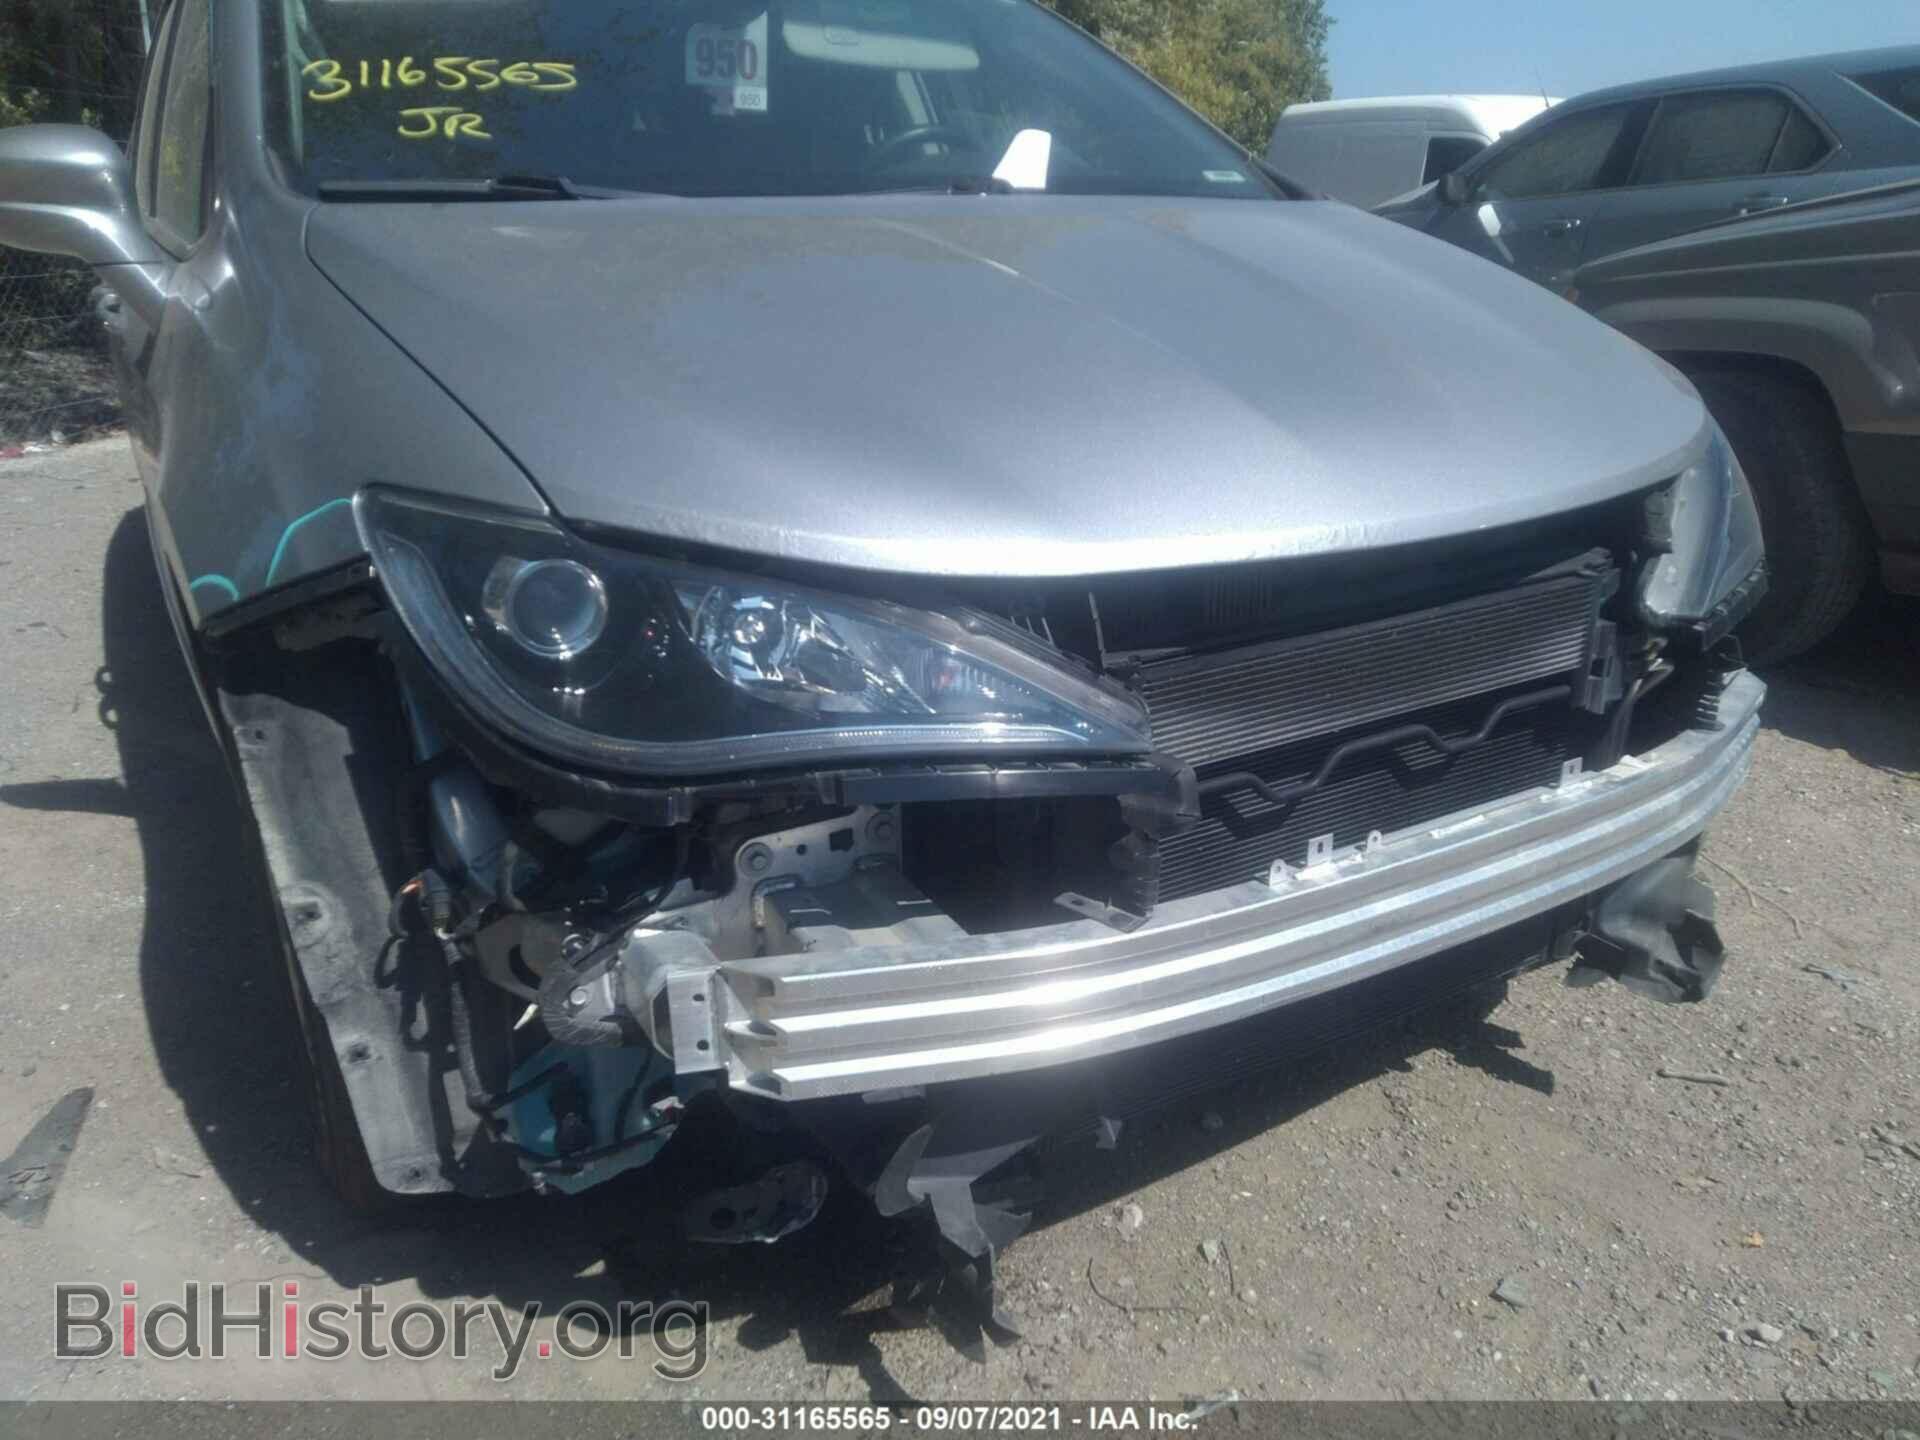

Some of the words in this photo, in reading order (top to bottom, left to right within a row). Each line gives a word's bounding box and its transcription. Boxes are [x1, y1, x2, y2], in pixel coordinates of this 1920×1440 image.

[302, 56, 578, 101] 31165565
[696, 37, 758, 81] 950
[397, 105, 493, 139] JR
